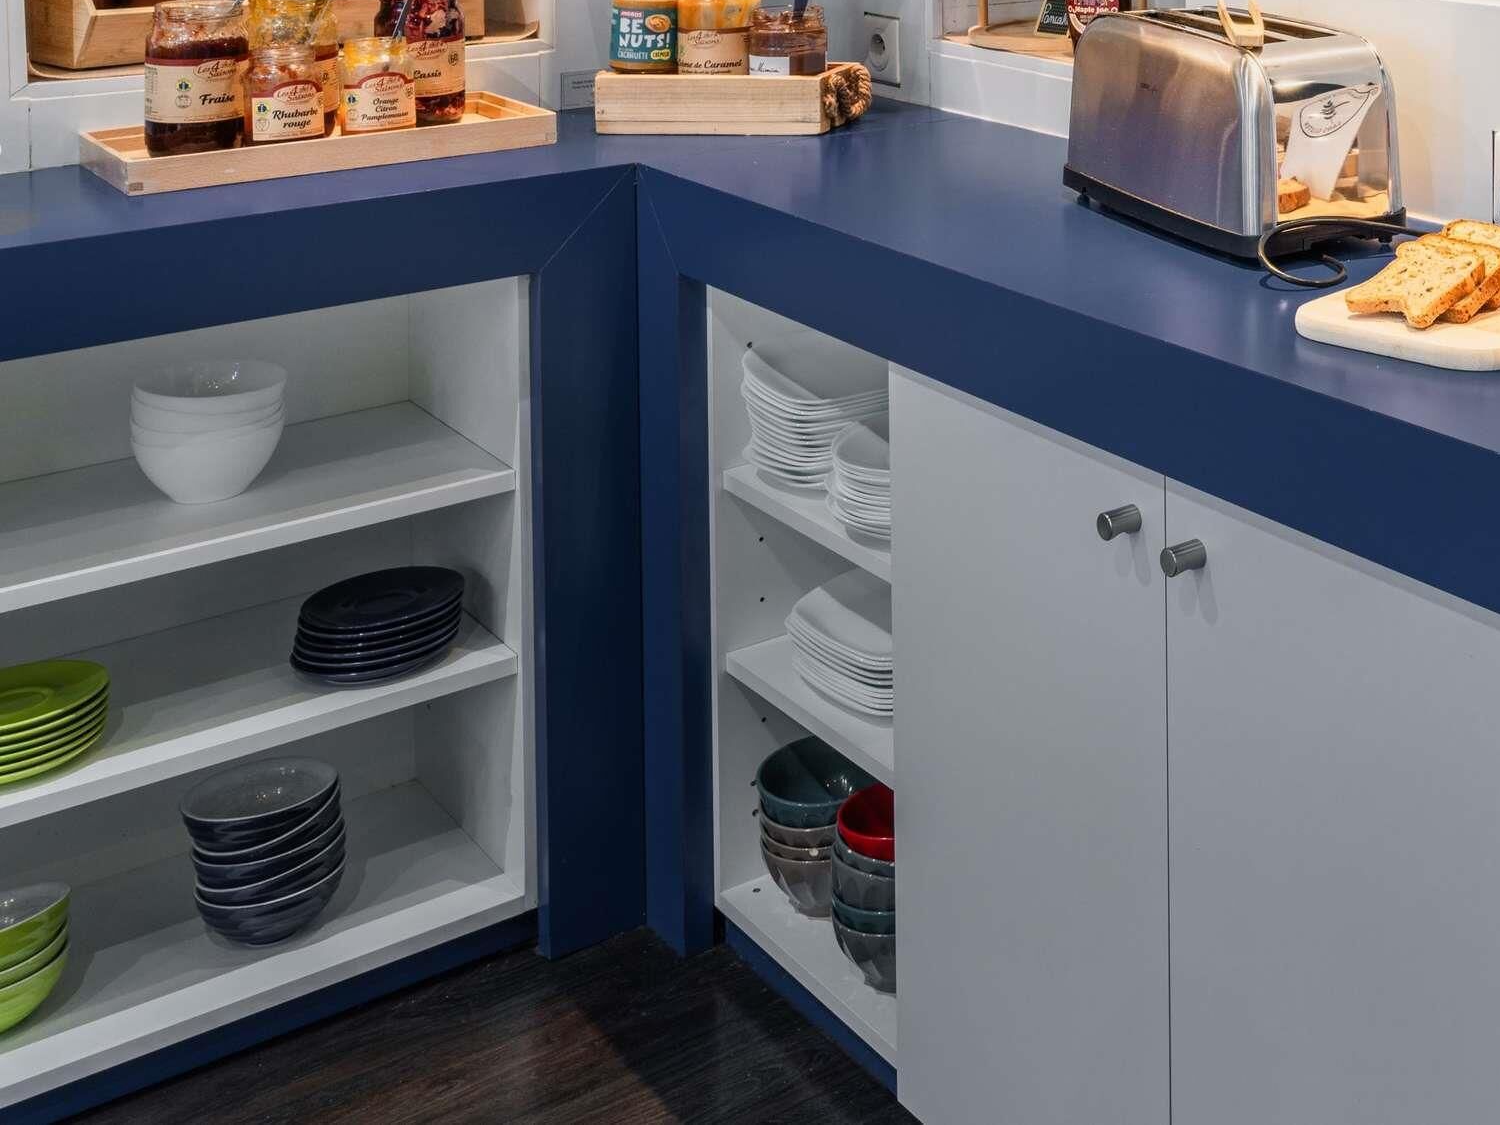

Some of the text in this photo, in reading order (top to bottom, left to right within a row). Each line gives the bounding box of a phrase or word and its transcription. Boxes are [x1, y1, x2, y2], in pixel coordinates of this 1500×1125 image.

[619, 17, 643, 33] BE
[619, 33, 670, 48] NUTS!
[703, 58, 743, 69] Caramel
[199, 93, 236, 106] Fraise
[372, 97, 399, 105] Orange
[272, 107, 319, 120] Rhubarbe
[375, 105, 398, 113] Citron
[282, 119, 311, 129] rouge
